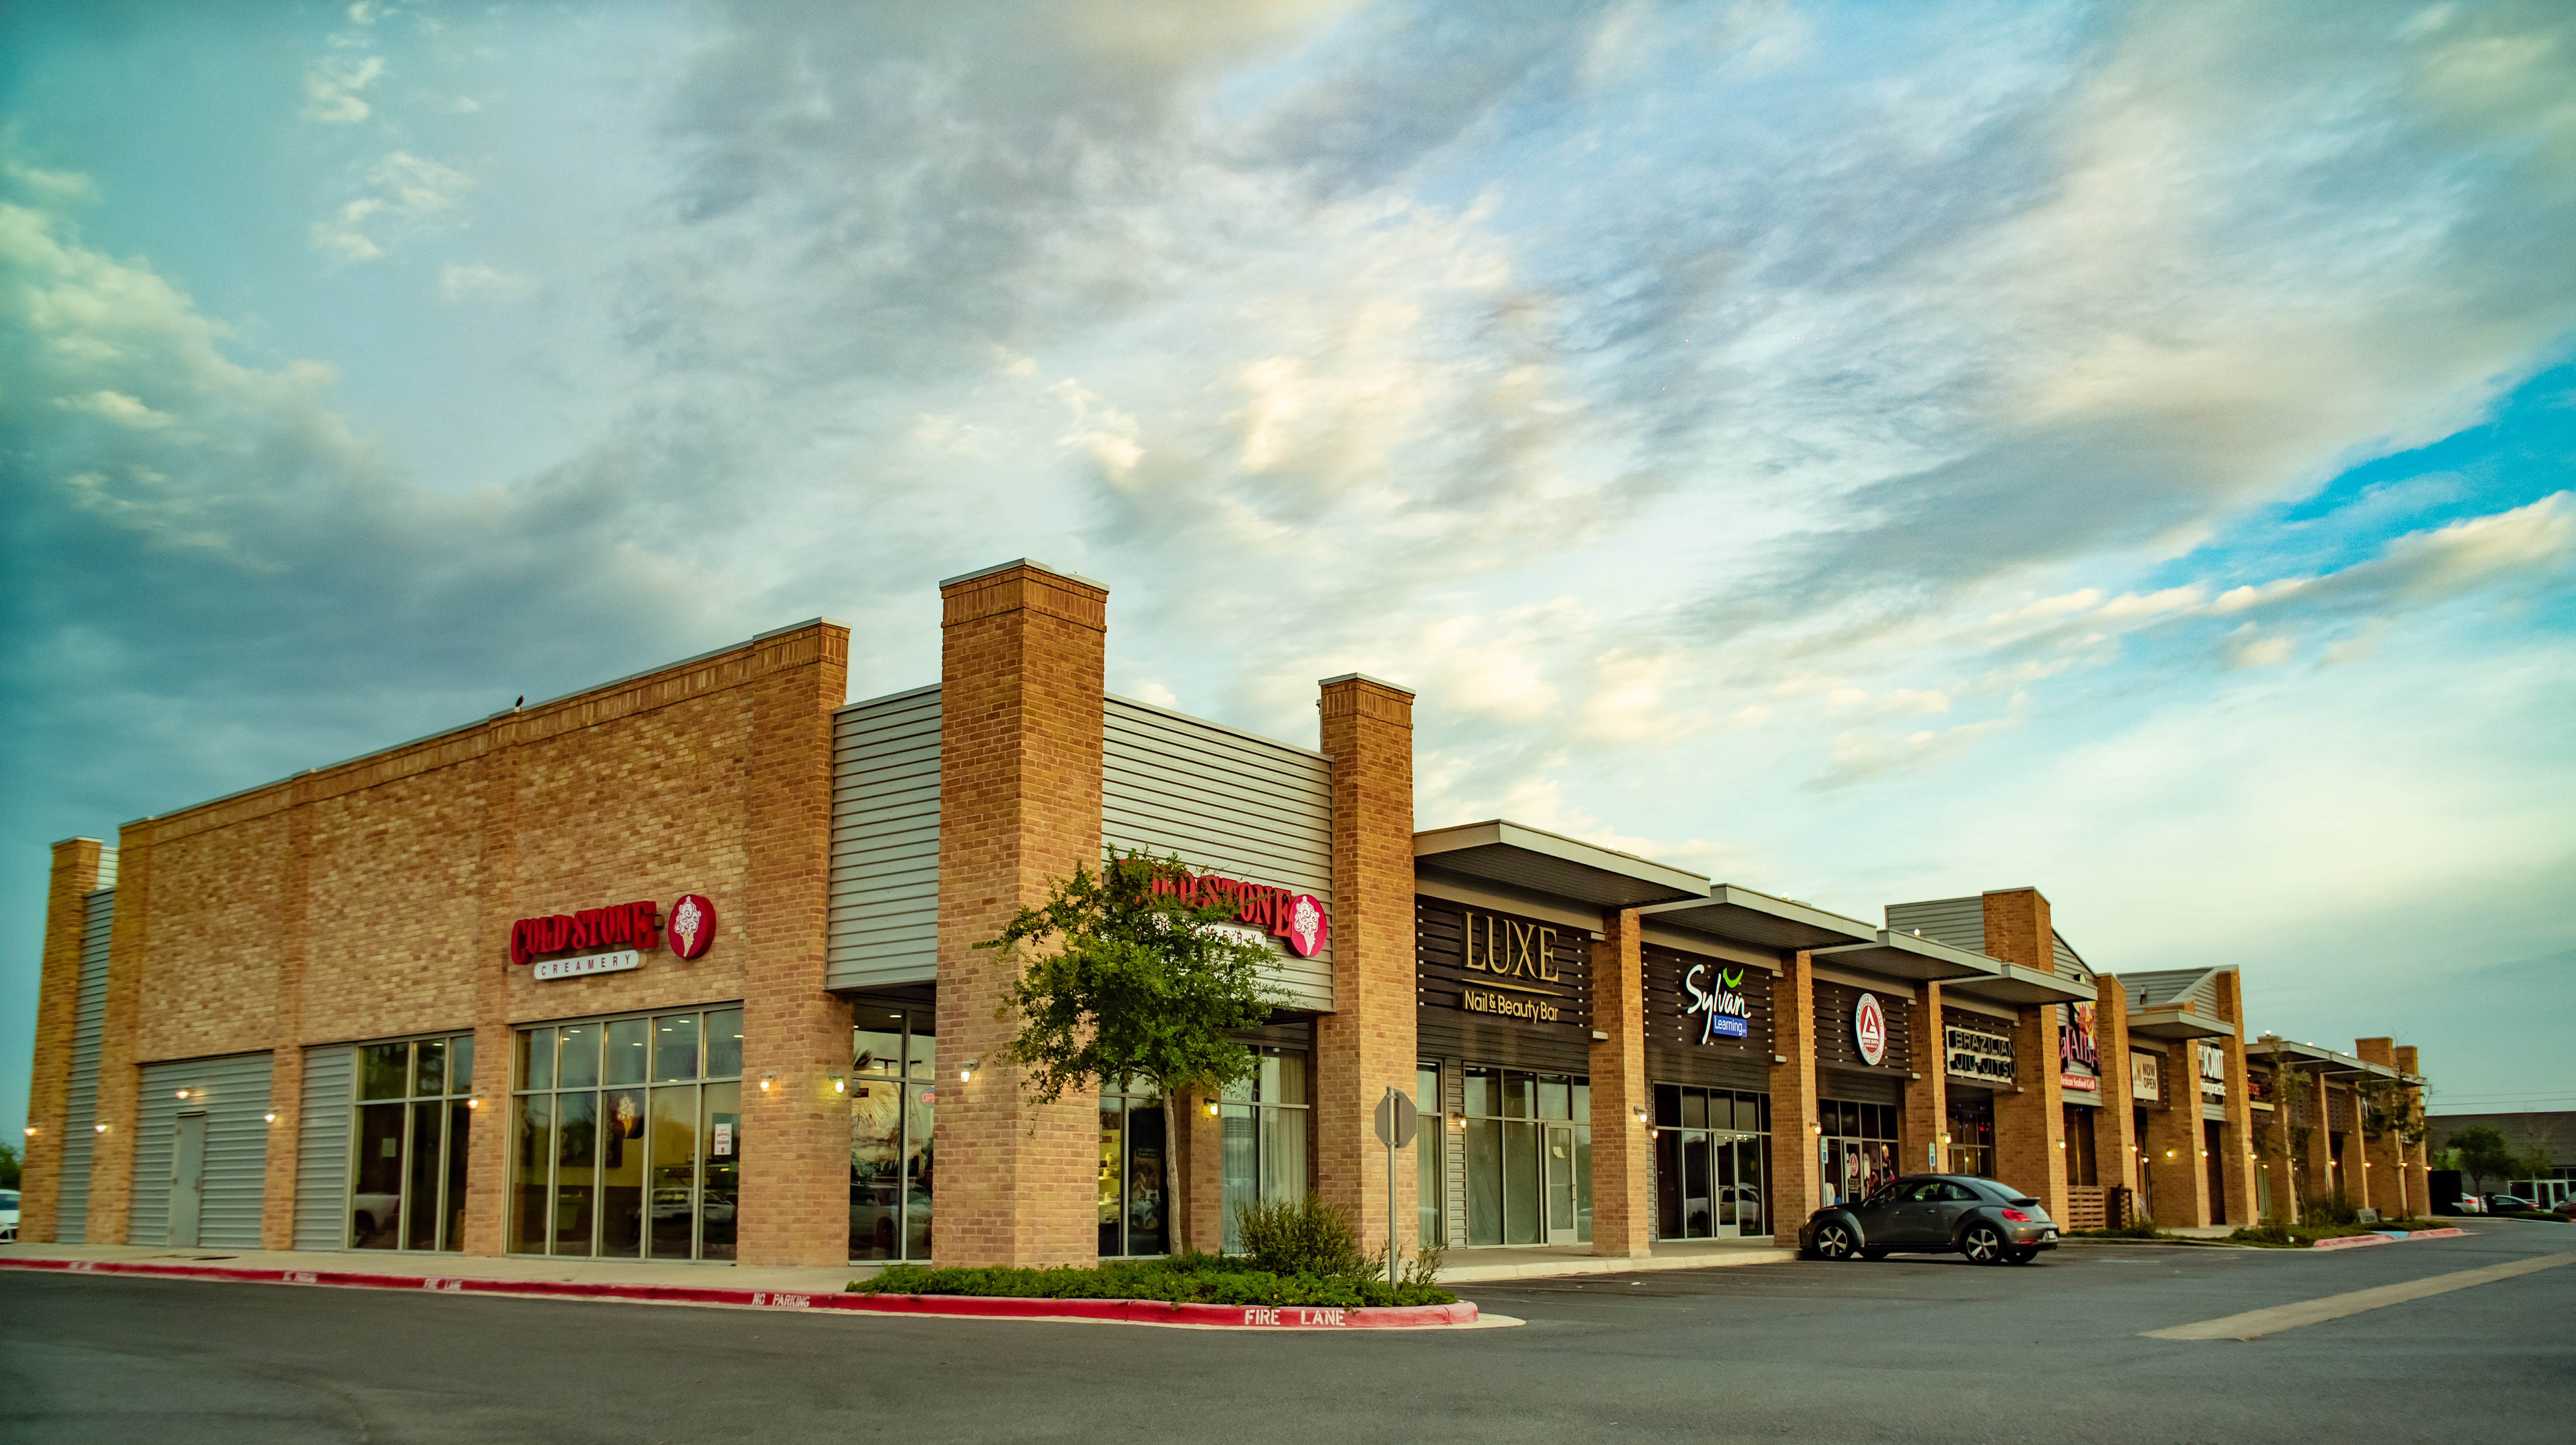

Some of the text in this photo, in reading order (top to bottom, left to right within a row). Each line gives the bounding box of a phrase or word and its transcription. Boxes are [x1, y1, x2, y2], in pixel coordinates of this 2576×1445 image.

[511, 901, 659, 965] COLD STONE
[1465, 911, 1559, 982] LUXE
[541, 954, 630, 976] CREAMERY
[1465, 990, 1559, 1024] Nail & Beauty Bar
[1686, 964, 1752, 1045] Sylvan
[1714, 1015, 1743, 1036] Learning
[1955, 1030, 2015, 1057] BRAZILIAN
[1955, 1053, 2016, 1078] JIU-JITSU
[2143, 1063, 2155, 1076] NOW
[2203, 1045, 2224, 1080] JOINT
[2143, 1077, 2156, 1089] OPEN
[2200, 1078, 2226, 1097] hiropractic
[752, 1292, 811, 1308] NO PARKING
[1244, 1309, 1346, 1326] FIRE LANE
